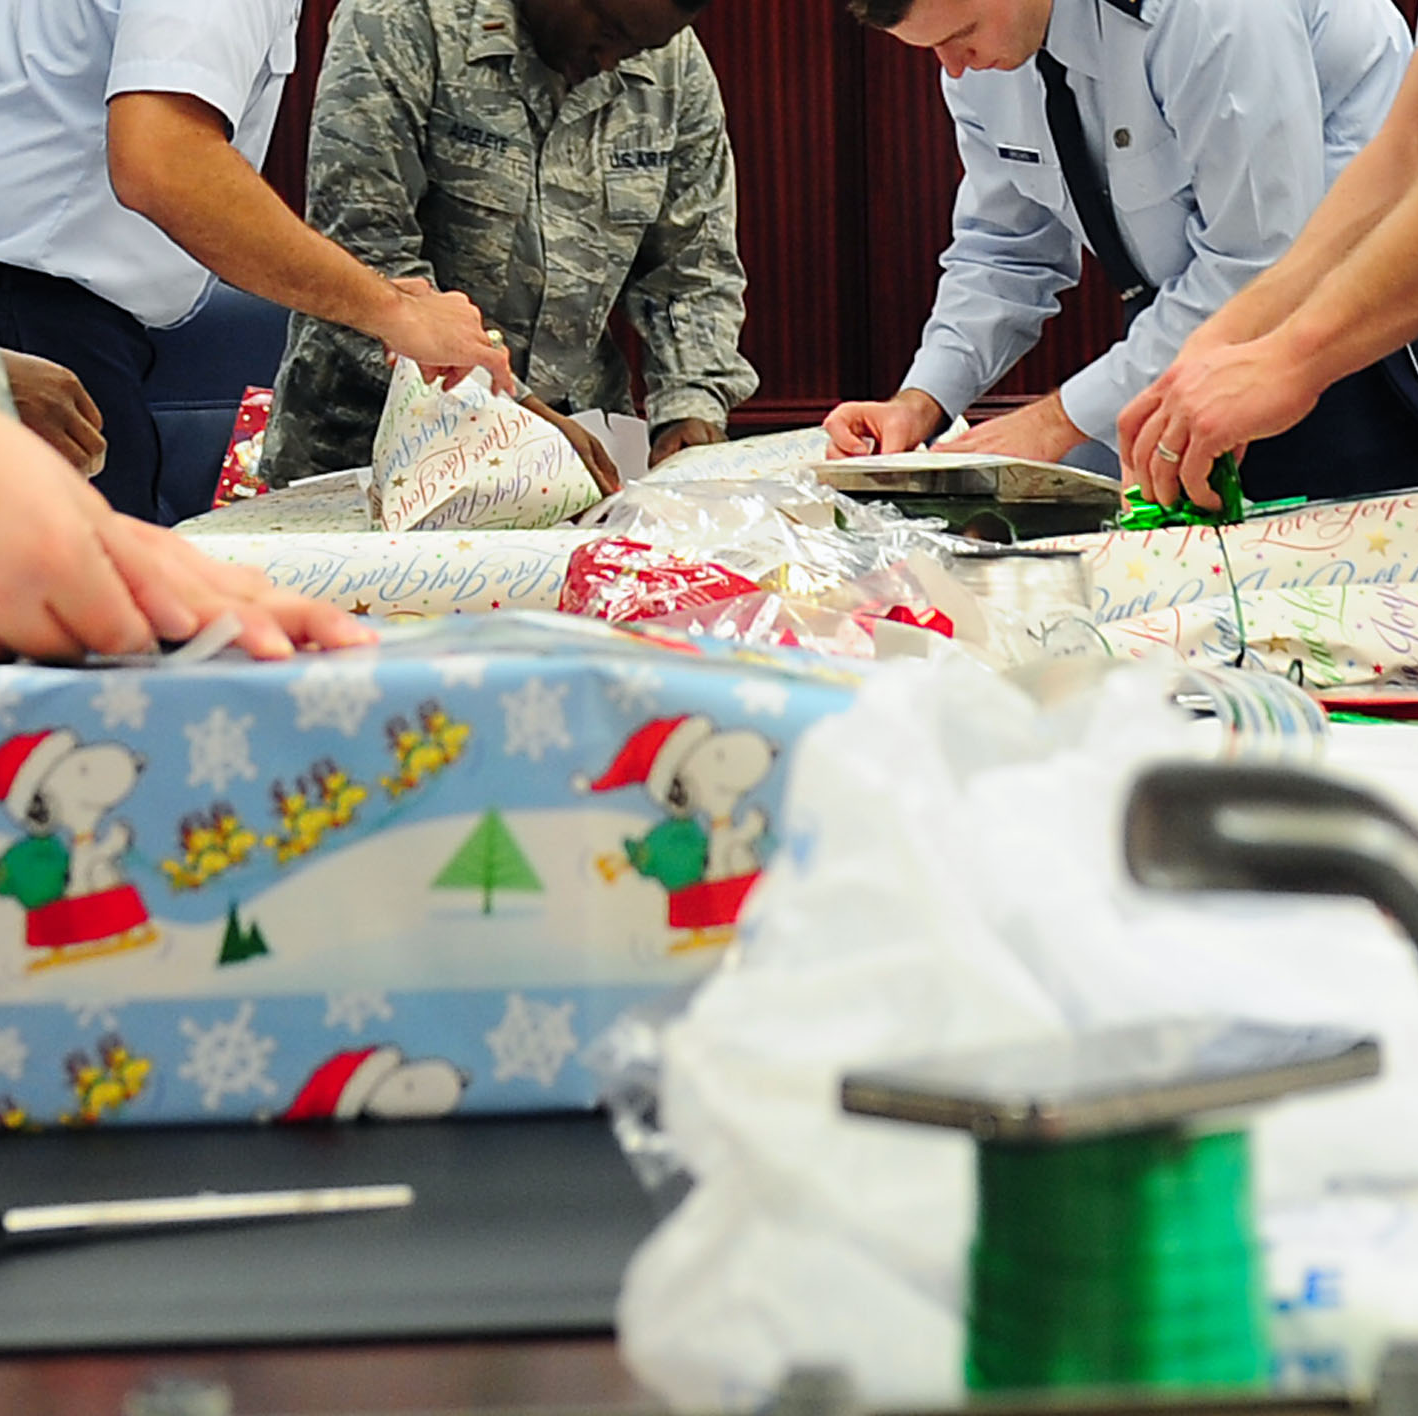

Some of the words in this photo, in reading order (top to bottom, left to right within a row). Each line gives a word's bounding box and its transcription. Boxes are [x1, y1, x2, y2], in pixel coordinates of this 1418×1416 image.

[448, 123, 511, 154] ADELEYE
[415, 436, 471, 481] Love
[471, 412, 522, 462] Peace
[516, 435, 563, 481] Love
[400, 466, 438, 516] Joy
[339, 552, 433, 601] Peace
[431, 556, 489, 602] Joy
[483, 546, 567, 599] Love
